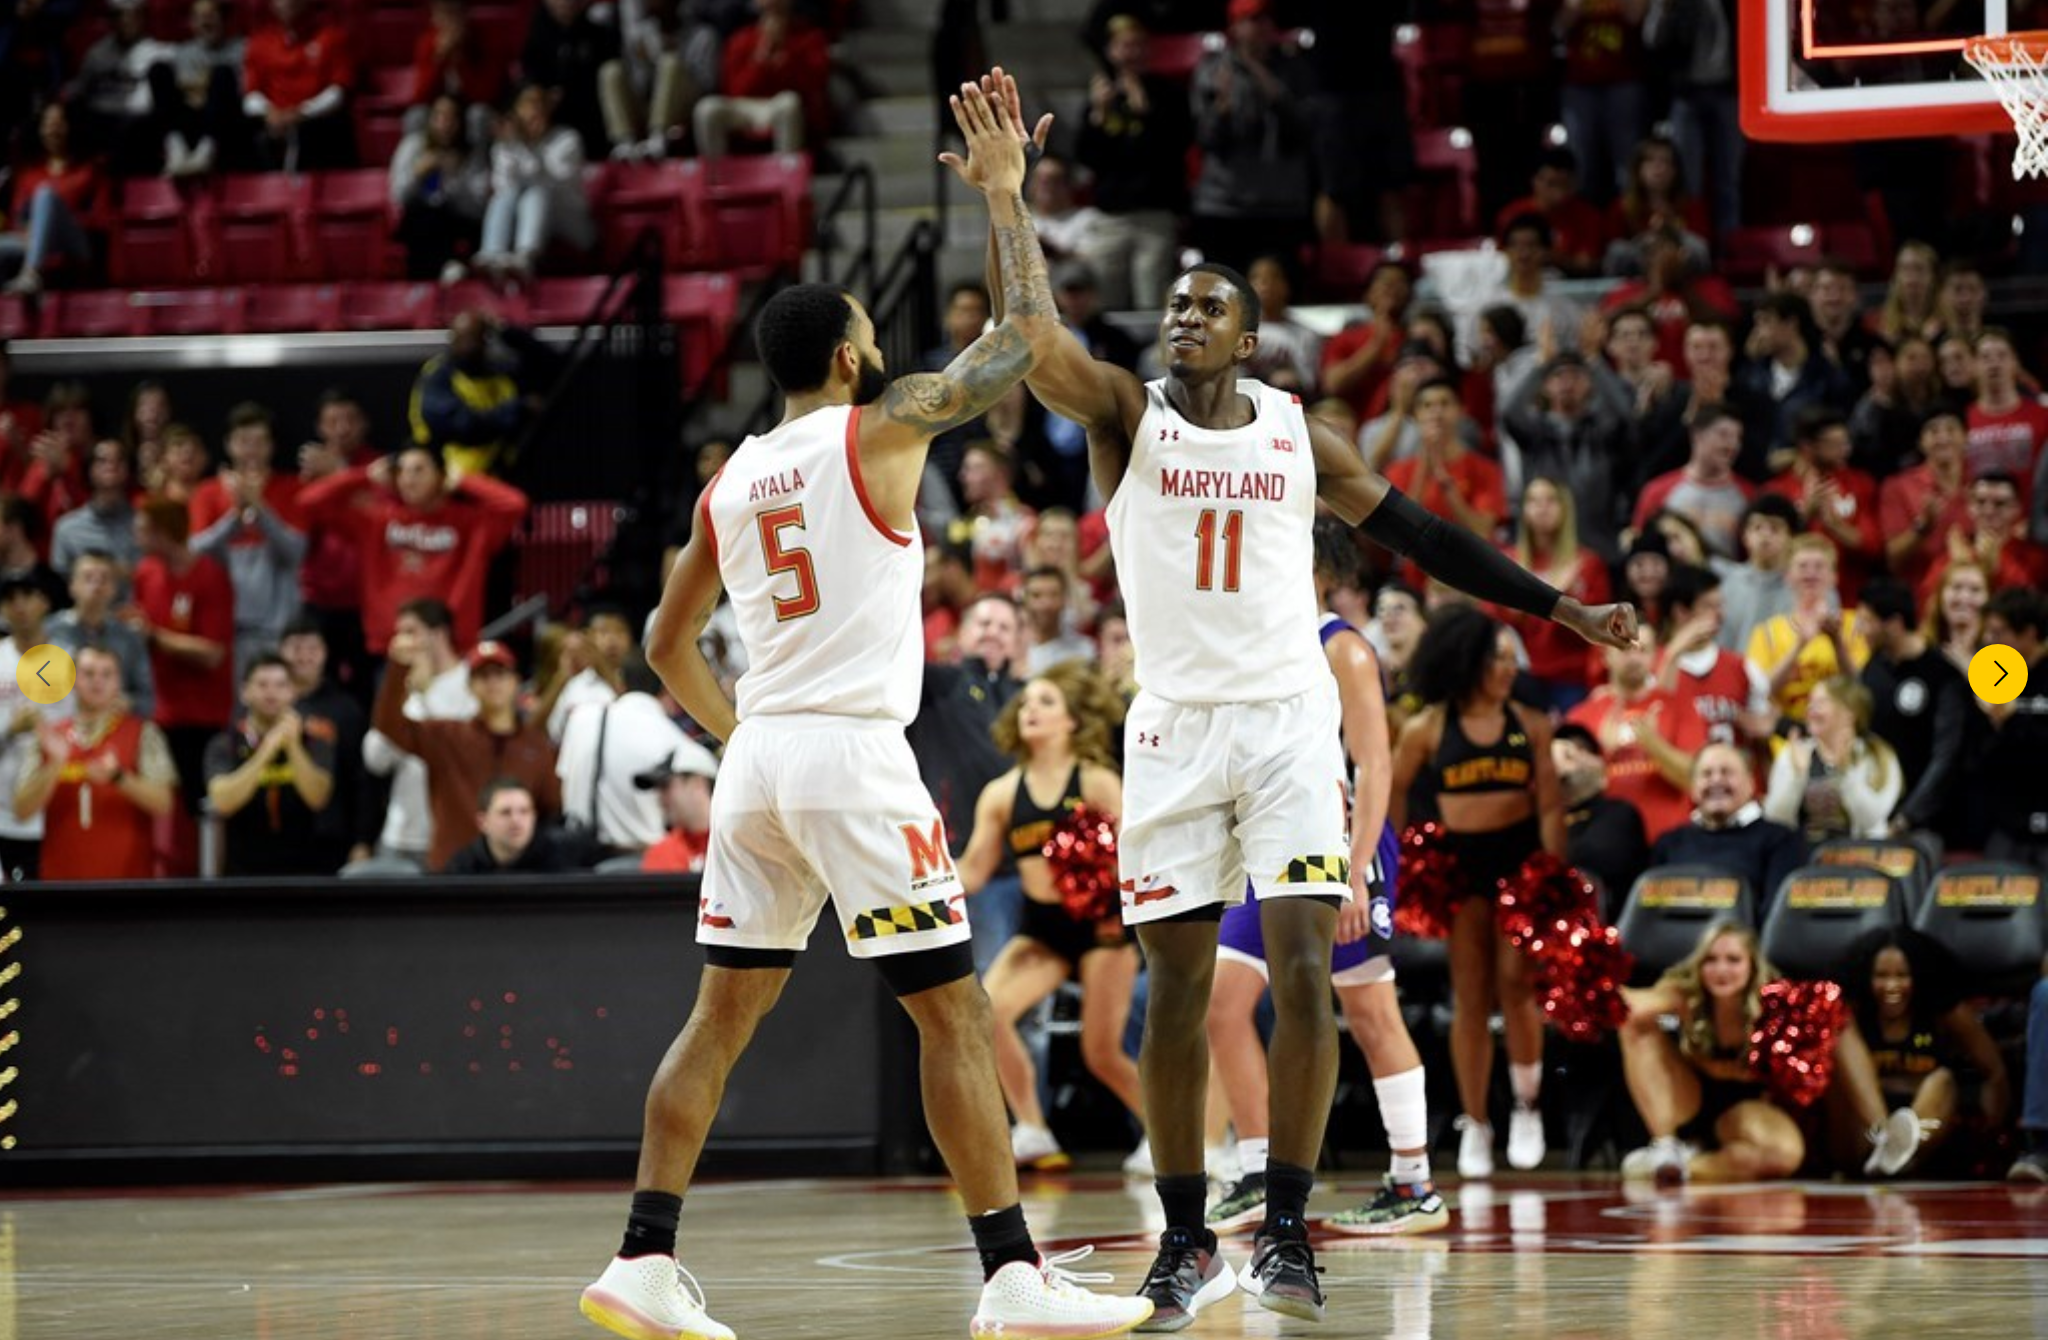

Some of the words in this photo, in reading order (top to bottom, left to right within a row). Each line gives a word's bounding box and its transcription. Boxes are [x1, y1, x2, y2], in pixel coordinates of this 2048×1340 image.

[748, 466, 805, 502] AYALA
[1160, 467, 1286, 502] MARYLAND
[756, 502, 821, 623] 5
[1194, 508, 1243, 593] 11
[898, 819, 953, 880] M
